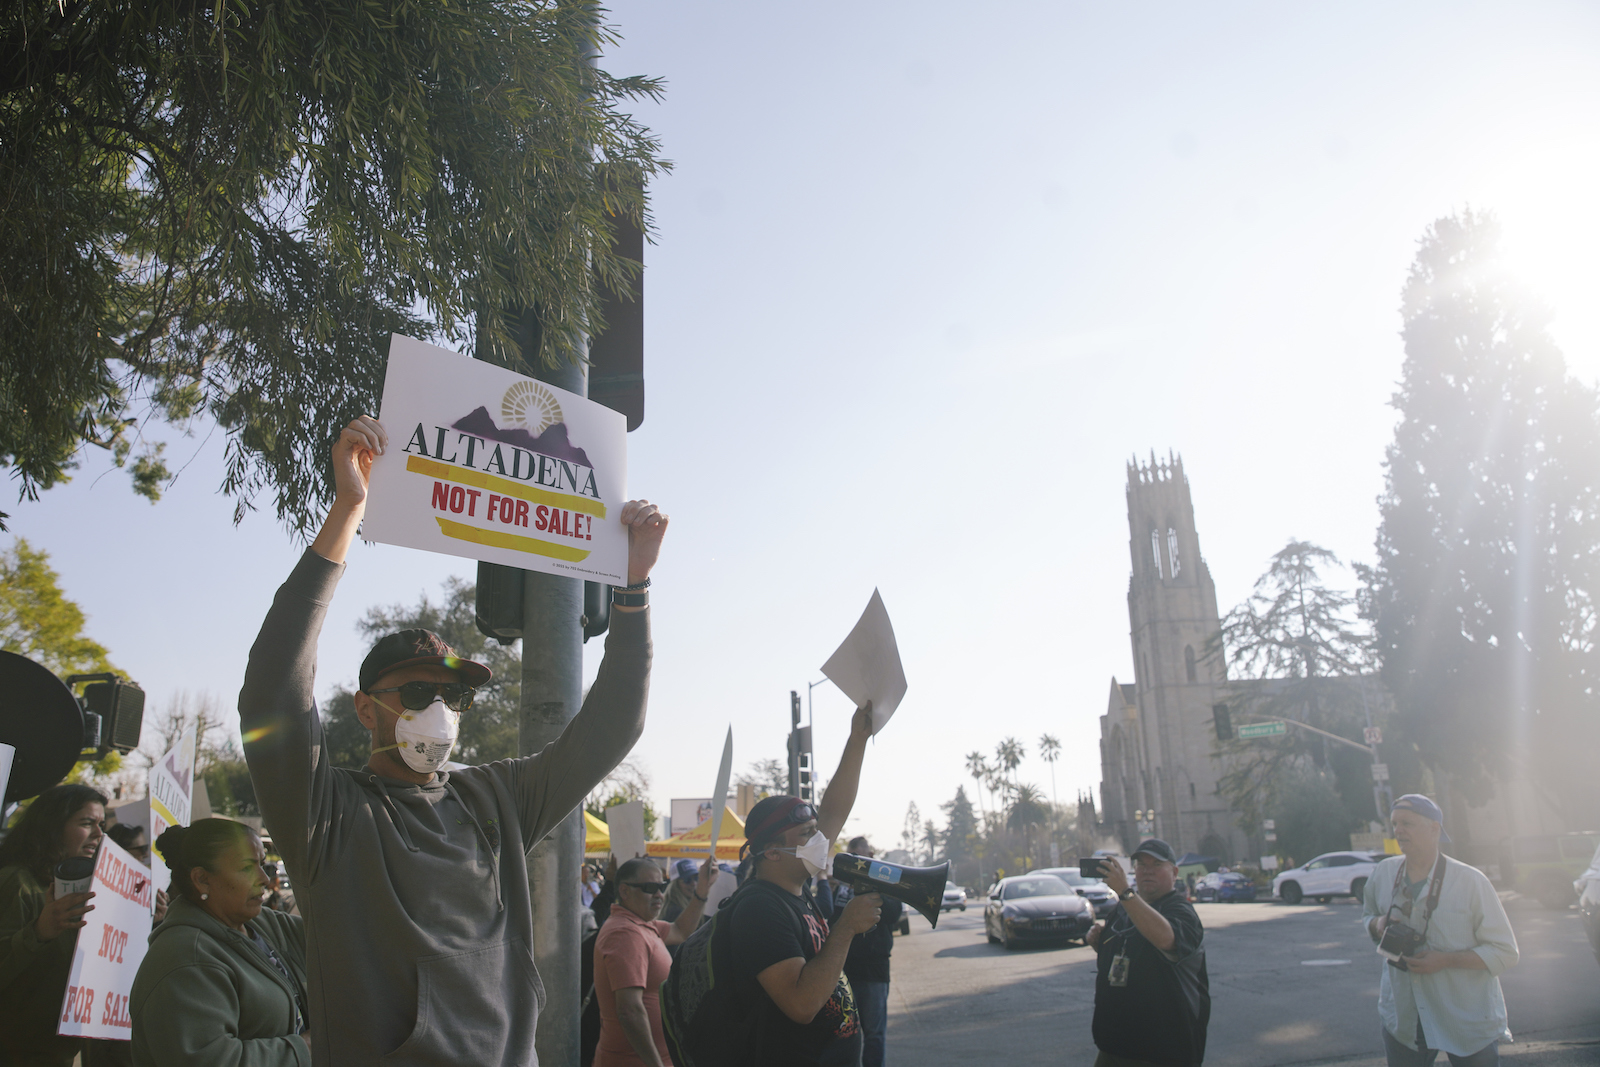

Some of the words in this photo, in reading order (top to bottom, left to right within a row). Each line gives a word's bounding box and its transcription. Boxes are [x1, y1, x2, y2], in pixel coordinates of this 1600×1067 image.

[402, 422, 601, 499] ALTADENA
[431, 481, 481, 517] NOT
[487, 494, 530, 528] FOR
[535, 505, 592, 541] SALE!
[98, 923, 128, 964] NOT
[62, 985, 94, 1024] FOR
[102, 991, 132, 1028] SAL
